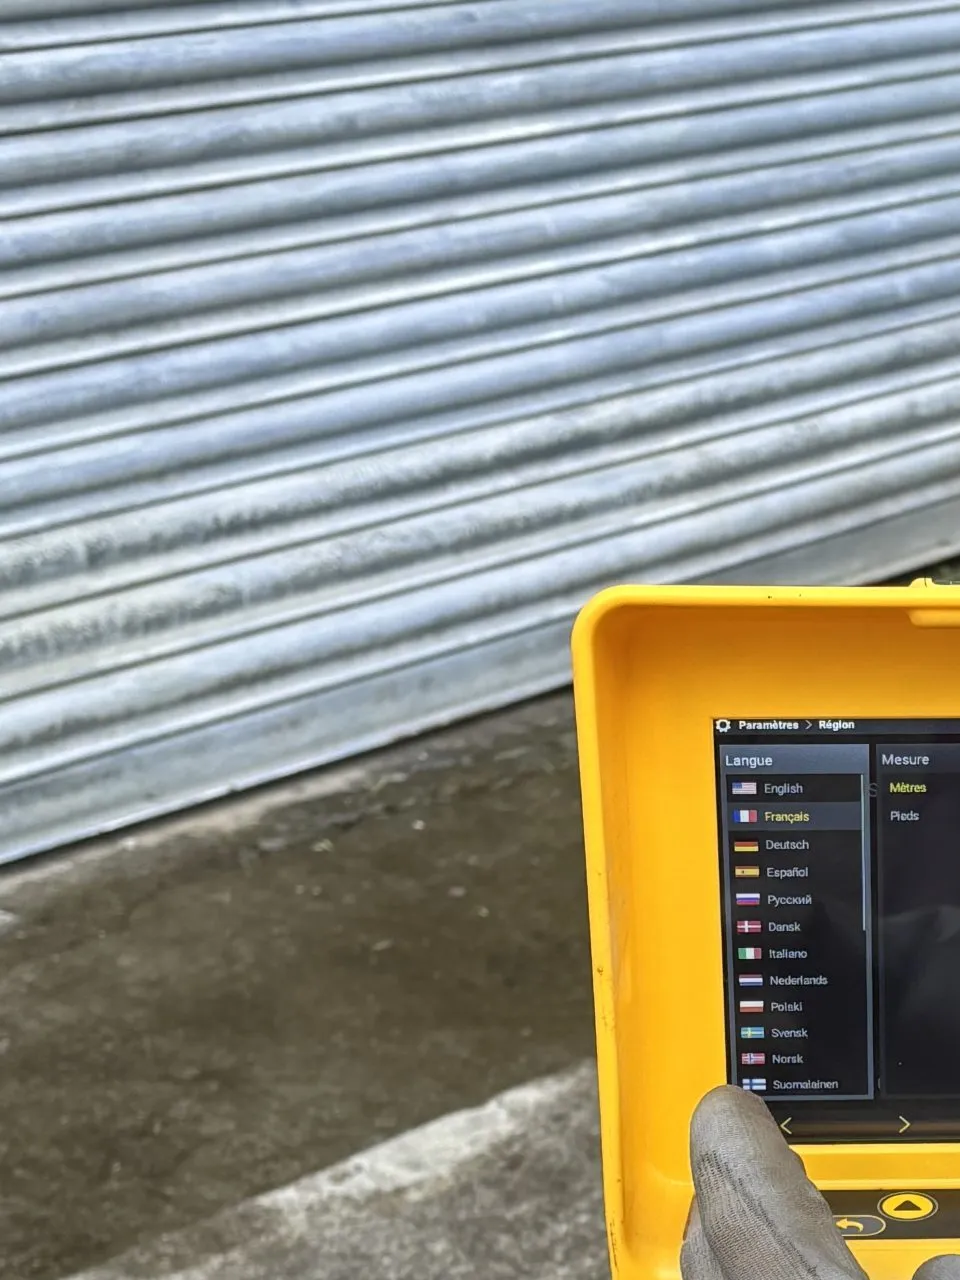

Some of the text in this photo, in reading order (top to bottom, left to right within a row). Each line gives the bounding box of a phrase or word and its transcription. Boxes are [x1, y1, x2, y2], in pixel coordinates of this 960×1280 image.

[738, 720, 854, 731] Paramètres Région
[726, 756, 772, 768] Langue
[882, 754, 929, 765] Mesure
[765, 783, 802, 795] English
[890, 782, 926, 792] Mètres
[765, 812, 809, 824] Français
[891, 811, 919, 820] Pieds
[766, 840, 809, 849] Deutsch
[767, 867, 808, 879] Español
[768, 895, 811, 907] Русский
[769, 922, 800, 931] Dansk
[770, 949, 807, 958] Italiano
[770, 976, 827, 985] Nederlands
[772, 1028, 807, 1037] Svensk
[773, 1054, 803, 1063] Norsk
[773, 1080, 838, 1089] Suomalainen
